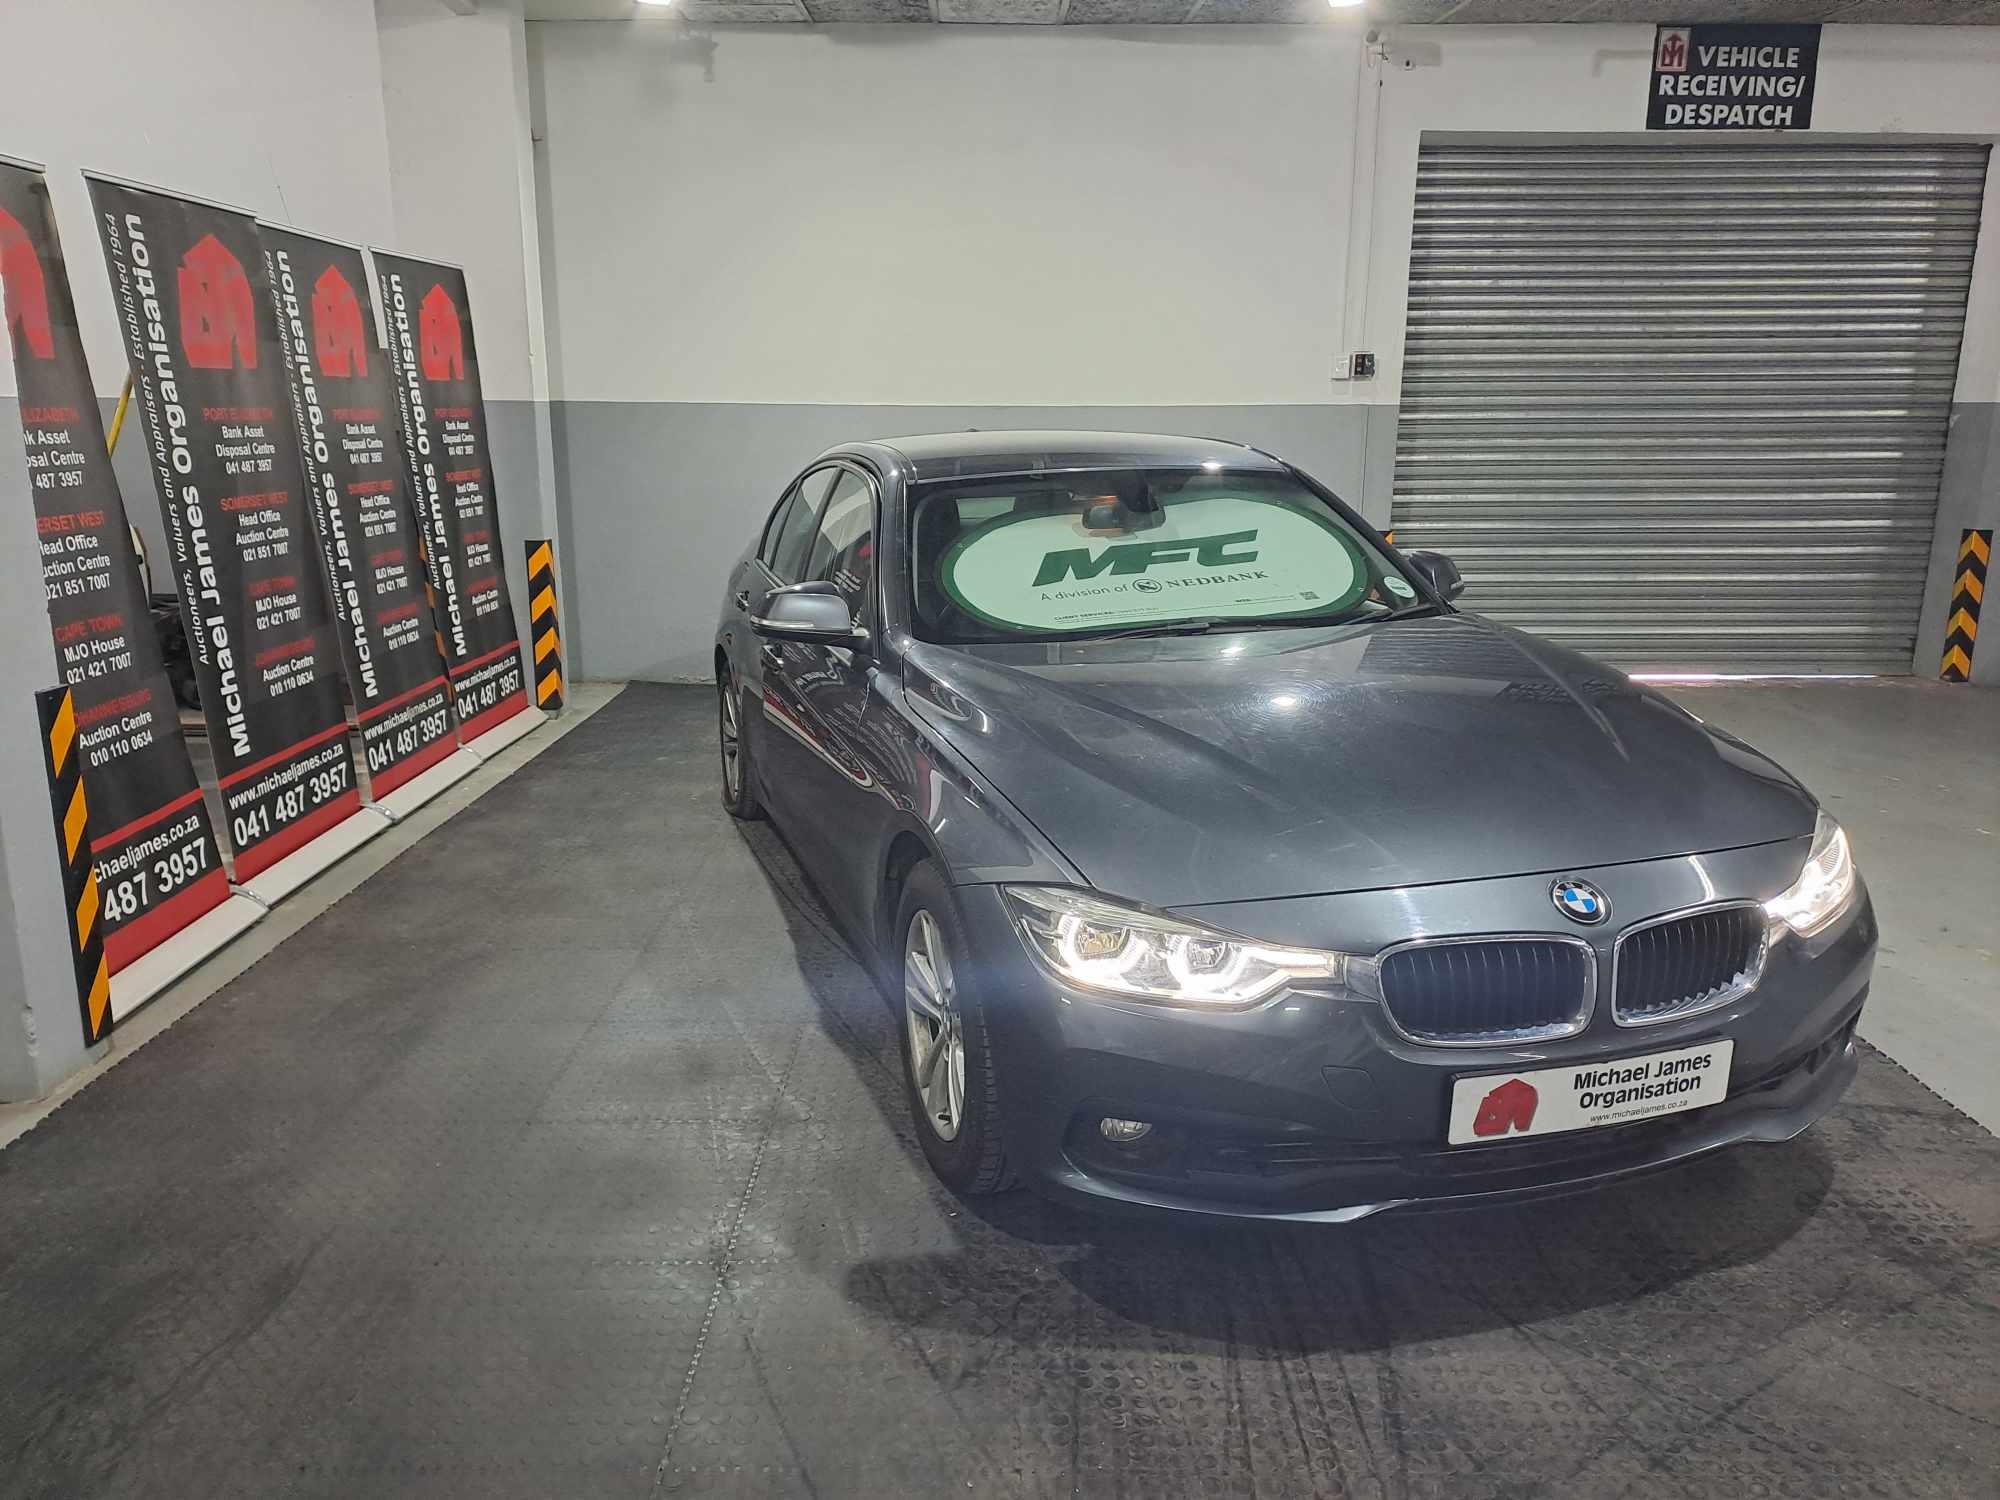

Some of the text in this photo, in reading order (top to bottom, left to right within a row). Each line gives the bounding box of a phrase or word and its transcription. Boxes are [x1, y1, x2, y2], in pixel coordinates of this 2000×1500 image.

[1697, 46, 1800, 69] VEHICLE
[1658, 75, 1806, 98] RECEIVING/
[1665, 104, 1793, 126] DESPATCH
[37, 429, 70, 446] Asset
[104, 212, 209, 665] Auctioneers, Valuers and Appraisers Established 1964
[221, 425, 265, 438] Bank Asset
[51, 450, 86, 466] Centre
[215, 442, 276, 459] Disposal Centre
[390, 274, 467, 657] Michael James Organisation
[35, 470, 83, 489] 487 3957
[225, 461, 240, 475] 041
[276, 250, 379, 698] Michael James Organisation
[125, 214, 251, 758] Michael James Organisation
[238, 510, 281, 526] Head Office
[312, 486, 328, 536] Valuers
[65, 534, 99, 551] Office
[236, 527, 289, 545] Auction Centre
[76, 553, 111, 572] Centre
[243, 547, 256, 562] 021
[1032, 529, 1259, 587] MFC
[64, 577, 86, 597] 851
[86, 572, 110, 591] 7007
[324, 541, 347, 621] Auctioneers,
[1040, 570, 1270, 601] A division of NEDBANK
[272, 594, 297, 608] House
[63, 635, 125, 664] MJO House
[66, 652, 132, 685] 021 421 7007
[263, 664, 291, 682] Auction
[457, 668, 519, 719] 041 487 3957
[79, 711, 152, 749] Auction Centre
[363, 692, 444, 741] www.michaeljames.co.za
[90, 730, 153, 767] 010 110 0634
[368, 709, 447, 771] 041 487 3957
[229, 743, 344, 810] www.michaeljames.co.za
[234, 761, 347, 846] 041 487 3957
[104, 836, 207, 922] 487 3957
[1573, 1053, 1712, 1090] Michael James
[1579, 1075, 1702, 1109] Organisation
[1590, 1100, 1688, 1123] www.michaeljames.co.za
